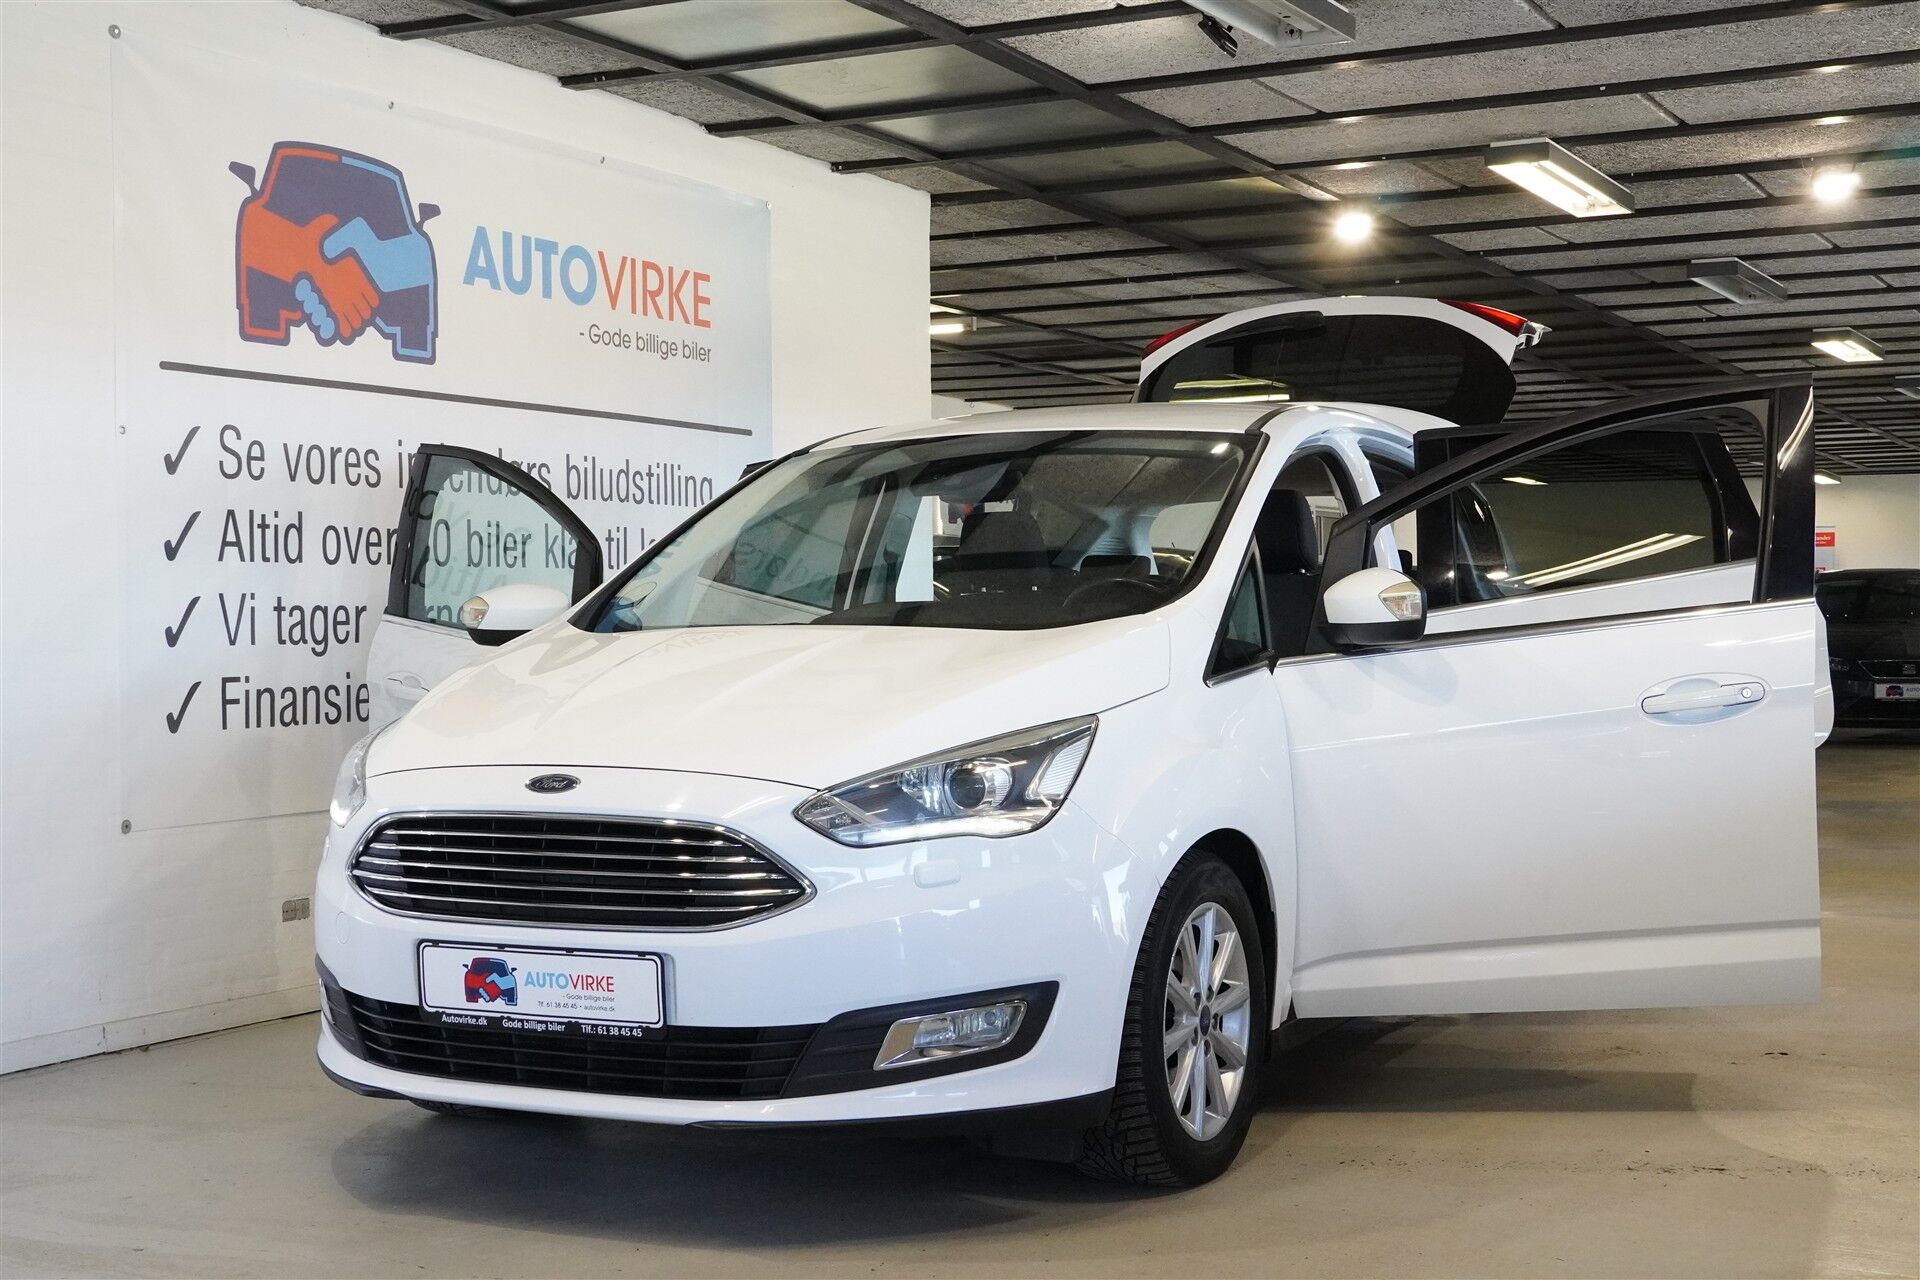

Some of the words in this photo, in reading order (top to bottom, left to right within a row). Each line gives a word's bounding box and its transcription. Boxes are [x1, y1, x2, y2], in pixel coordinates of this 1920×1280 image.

[463, 225, 711, 328] AUTOVIRKE
[588, 323, 631, 349] Gode
[636, 331, 678, 360] billige
[682, 340, 711, 362] biler
[218, 424, 265, 481] Se
[283, 443, 381, 488] vores
[566, 454, 712, 508] biludstilling
[218, 509, 303, 565] Altid
[322, 525, 399, 565] over
[467, 519, 532, 569] biler
[545, 523, 577, 570] kla
[605, 526, 627, 570] til
[218, 593, 255, 646] Vi
[273, 596, 367, 657] tager
[535, 777, 570, 789] Ford
[524, 971, 615, 992] AUTOVIRKE
[566, 993, 582, 1001] Gode
[584, 994, 602, 1003] billige
[441, 1014, 488, 1026] Autovirke.dk
[502, 1018, 523, 1029] Gode
[523, 1020, 547, 1032] billige
[548, 1021, 566, 1032] biler
[581, 1024, 597, 1035] Tlf.:
[597, 1026, 608, 1035] 61
[609, 1027, 620, 1036] 38
[620, 1027, 631, 1037] 45
[632, 1028, 643, 1038] 45
